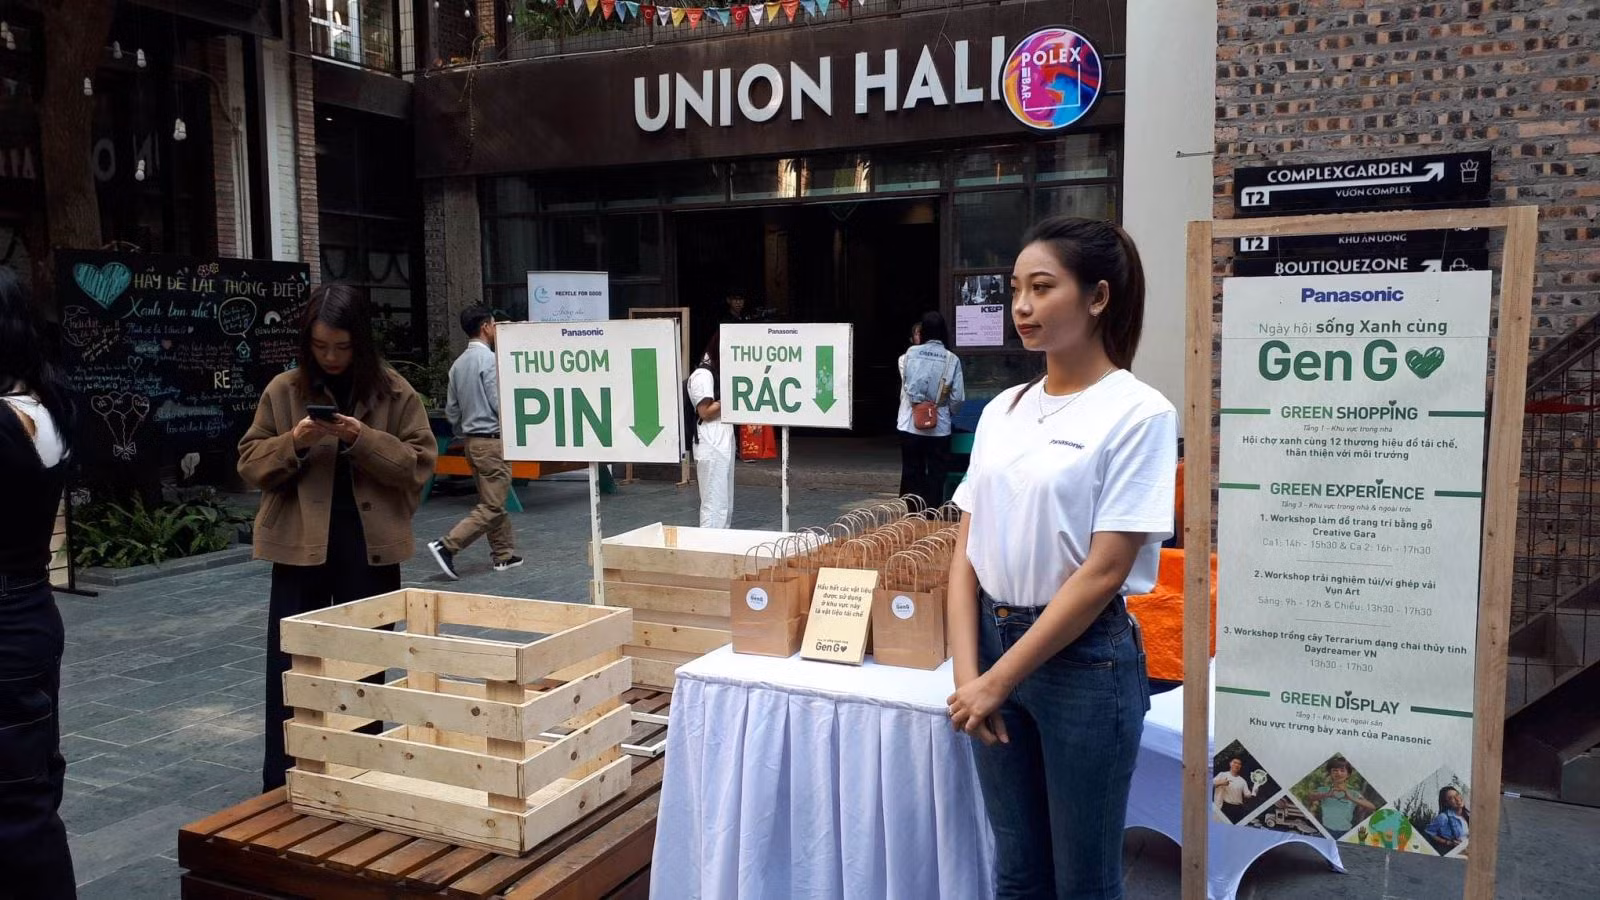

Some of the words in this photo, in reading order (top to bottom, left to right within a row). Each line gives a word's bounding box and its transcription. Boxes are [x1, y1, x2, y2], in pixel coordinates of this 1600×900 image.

[1022, 47, 1081, 66] POLEX
[634, 56, 832, 133] UNION
[1267, 161, 1413, 184] COMPLEXGARDEN
[1246, 191, 1265, 206] T2
[1366, 185, 1412, 195] COMPLEX
[1245, 238, 1264, 250] T2
[1338, 236, 1359, 244] KHU
[1275, 257, 1408, 275] BOUTIQUEZONE
[1301, 287, 1404, 303] Panasonic
[561, 327, 604, 336] Panasonic
[1259, 323, 1289, 336] Ngày
[1294, 322, 1312, 334] hội
[1316, 317, 1354, 336] sống
[1359, 319, 1401, 334] Xanh
[1407, 318, 1448, 336] cùng
[510, 350, 555, 373] THU
[560, 349, 610, 373] GOM
[731, 345, 763, 362] THU
[766, 345, 802, 362] GOM
[1259, 340, 1352, 381] Gen
[1363, 339, 1398, 382] G
[732, 365, 802, 413] RÁC
[513, 387, 612, 448] PIN
[1281, 405, 1333, 419] GREEN
[1336, 401, 1418, 420] SHOPPING
[1242, 435, 1258, 445] Hội
[1260, 436, 1278, 446] chợ
[1280, 437, 1302, 445] xanh
[1304, 436, 1327, 447] cùng
[1331, 437, 1341, 446] 12
[1344, 438, 1379, 448] thương
[1382, 438, 1403, 448] hiệu
[1310, 448, 1334, 458] thiện
[1336, 450, 1351, 458] với
[1374, 450, 1409, 461] trường
[1270, 482, 1322, 496] GREEN
[1326, 480, 1425, 501] EXPERIENCE
[1260, 513, 1268, 522] 1.
[1270, 513, 1316, 525] Workshop
[1319, 515, 1336, 525] làm
[1353, 518, 1378, 528] trang
[1313, 527, 1352, 537] Creative
[1354, 529, 1376, 538] Gara
[1311, 540, 1337, 549] 15h30
[1377, 544, 1392, 552] 16h
[1403, 545, 1431, 554] 17h30
[1254, 570, 1263, 578] 2.
[1265, 570, 1310, 582] Workshop
[1395, 579, 1419, 589] ghép
[1325, 586, 1342, 596] Vụn
[1345, 587, 1360, 596] Art
[1306, 599, 1321, 608] 12h
[1367, 603, 1394, 613] 13h30
[1404, 606, 1432, 616] 17h30
[816, 641, 832, 652] Gen
[833, 643, 840, 652] G
[1223, 626, 1232, 634] 3.
[1234, 626, 1279, 639] Workshop
[1307, 632, 1323, 643] cây
[1325, 634, 1373, 646] Terrarium
[1375, 639, 1399, 650] dạng
[1401, 641, 1421, 651] chai
[1304, 644, 1361, 657] Daydreamer
[1363, 649, 1377, 658] VN
[1310, 659, 1337, 669] 13h30
[1346, 662, 1374, 673] 17h30
[1281, 691, 1331, 708] GREEN
[1335, 691, 1400, 715] DISPLAY
[1249, 717, 1267, 726] Khu
[1269, 720, 1286, 729] vực
[1289, 722, 1315, 733] trưng
[1317, 724, 1333, 735] bày
[1336, 728, 1359, 737] xanh
[1361, 729, 1378, 739] của
[1381, 732, 1432, 745] Panasonic
